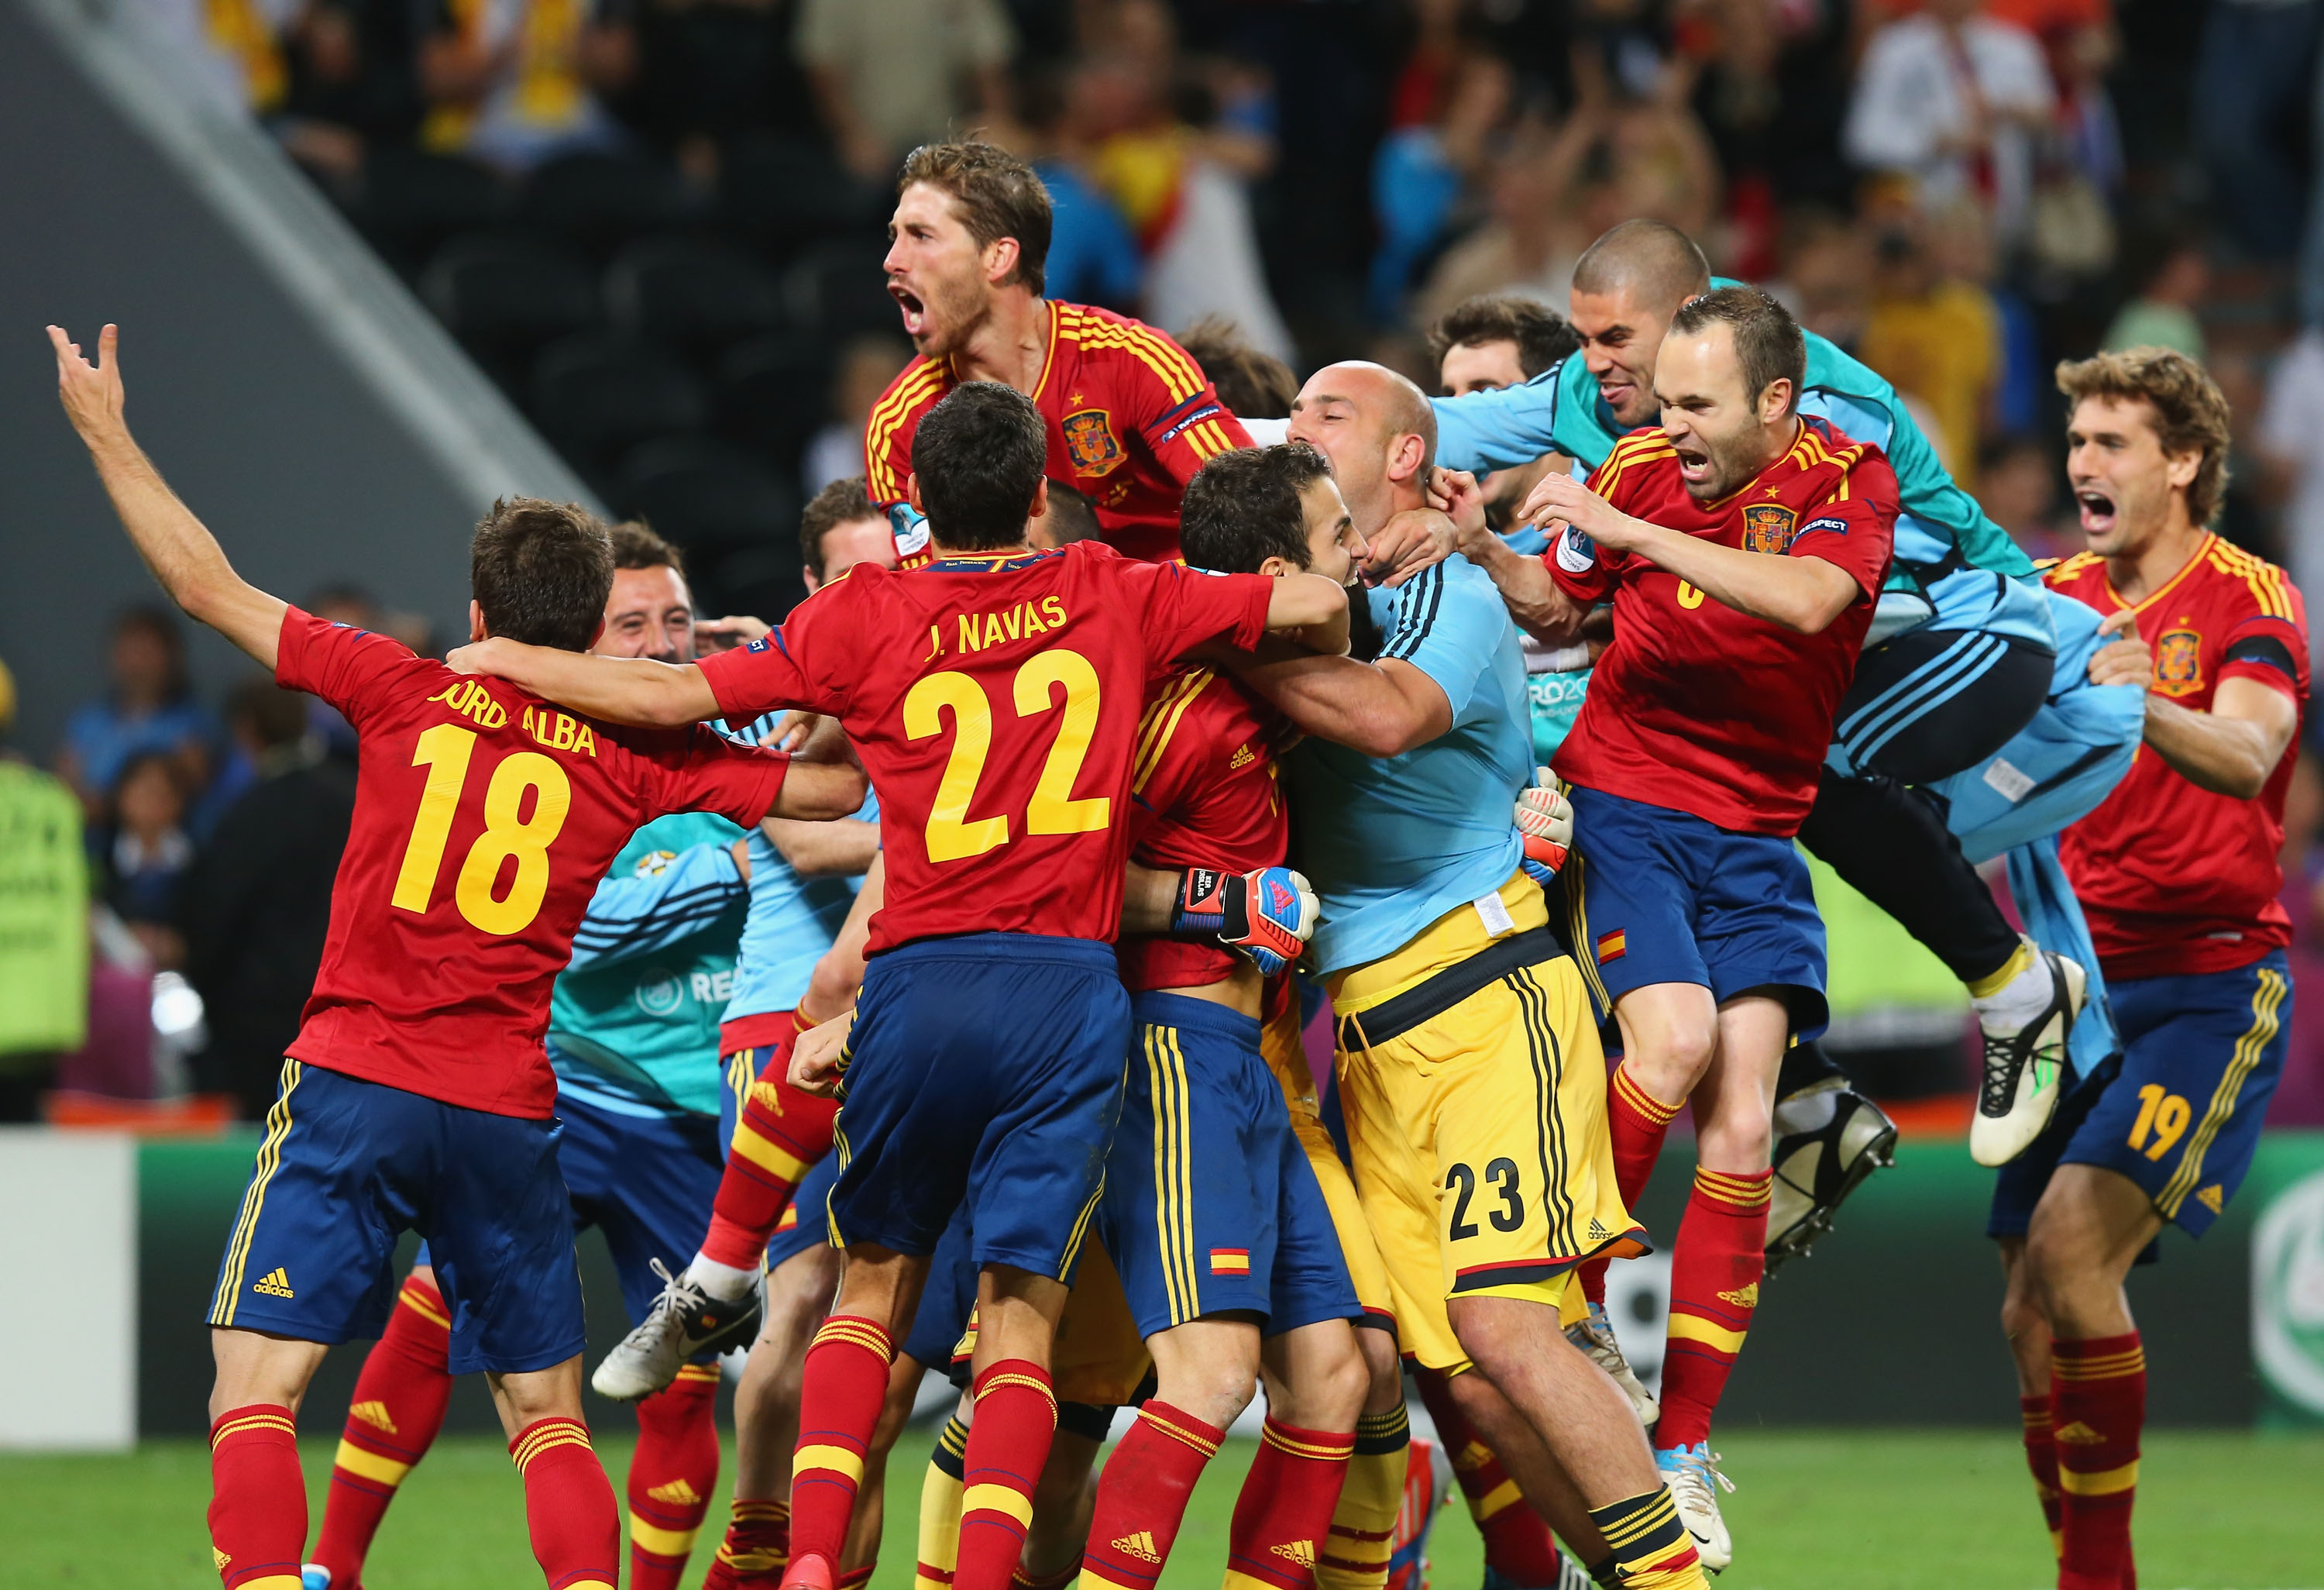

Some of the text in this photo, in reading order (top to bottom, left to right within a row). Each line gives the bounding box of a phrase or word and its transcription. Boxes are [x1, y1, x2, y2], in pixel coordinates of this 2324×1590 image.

[1800, 519, 1846, 535] RESPECT
[924, 595, 1067, 662] J. NAVAS
[426, 680, 596, 757] JORD ALBA
[902, 649, 1109, 863] 22
[1230, 752, 1255, 769] adidas
[390, 723, 572, 935] 18
[1197, 870, 1205, 897] CASILLAS
[2126, 1083, 2192, 1162] 19
[1445, 1157, 1525, 1242] 23
[253, 1283, 294, 1299] adidas
[1111, 1539, 1162, 1564] adidas
[1270, 1546, 1315, 1570] adidas
